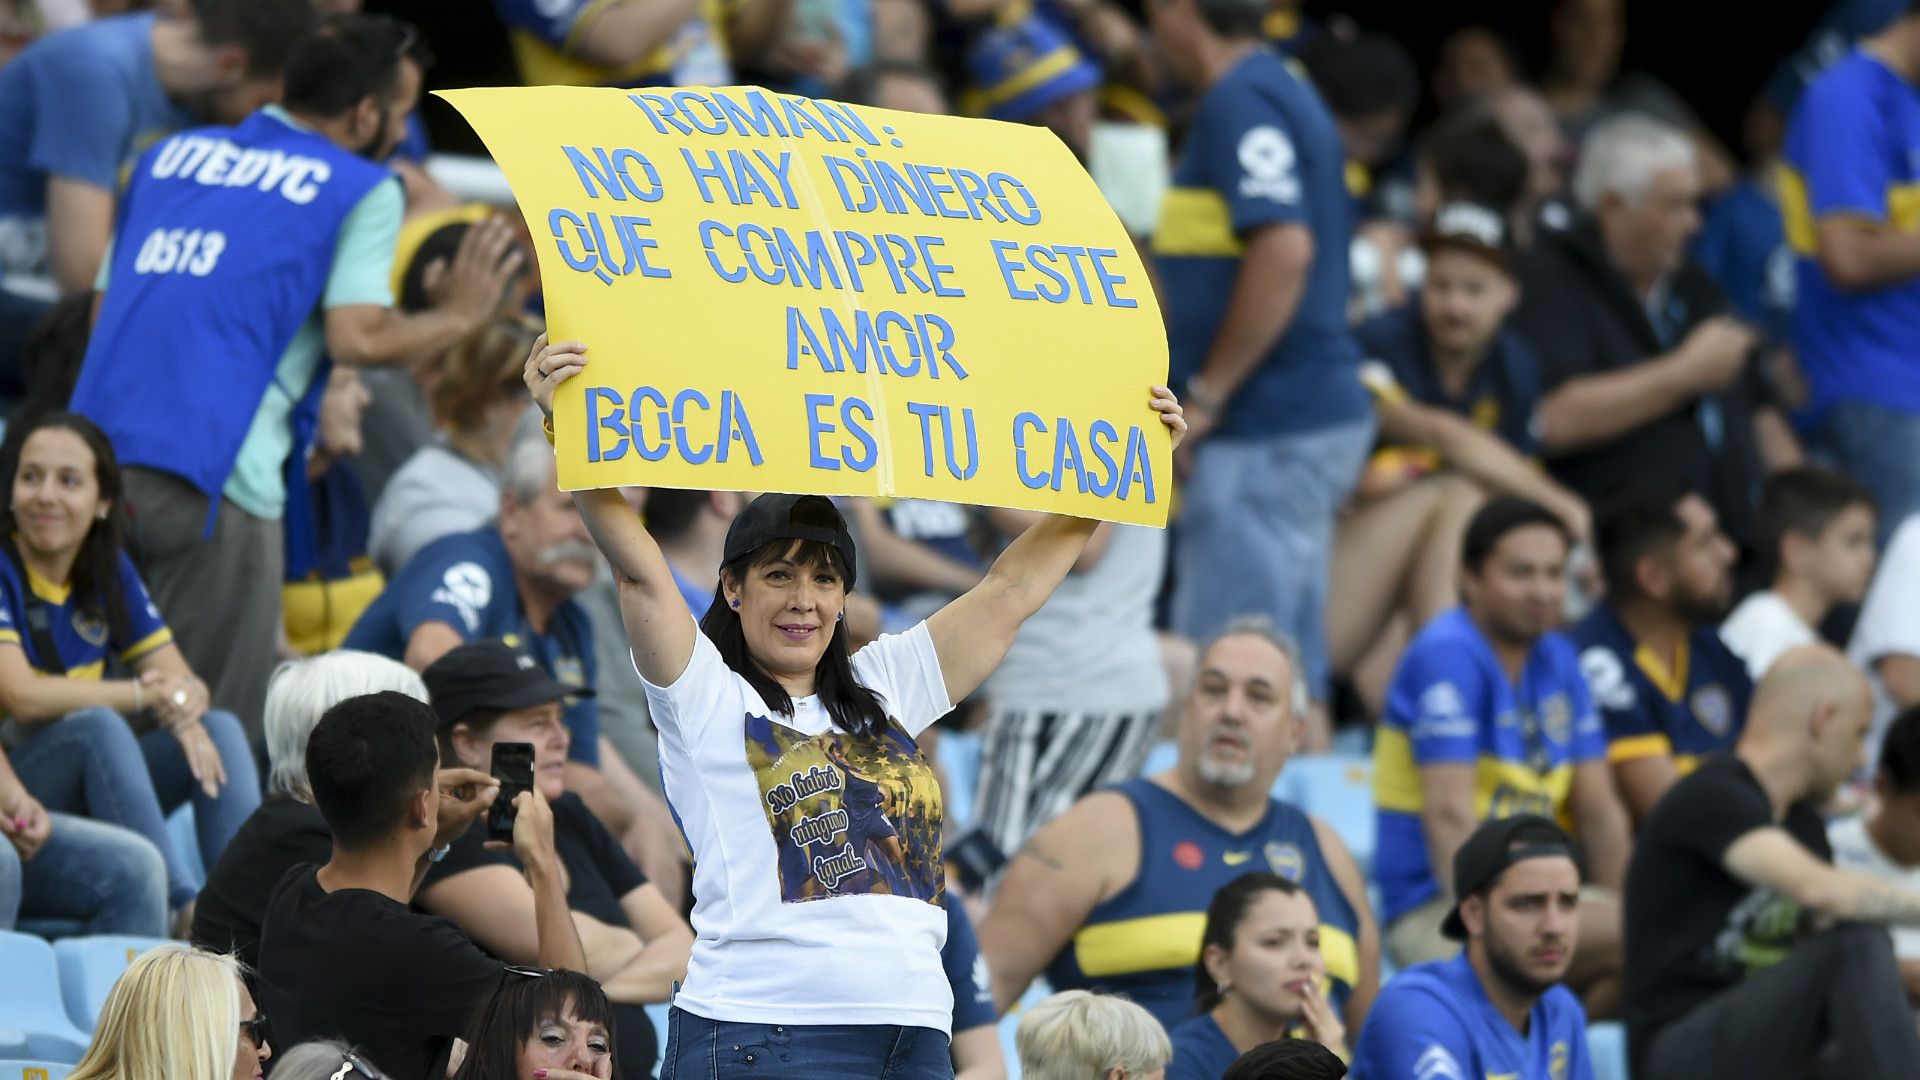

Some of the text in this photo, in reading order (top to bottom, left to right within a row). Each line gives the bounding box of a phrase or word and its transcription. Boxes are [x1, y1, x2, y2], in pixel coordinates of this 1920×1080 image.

[151, 134, 332, 205] UTEDYC
[561, 145, 664, 202] NO
[679, 147, 799, 209] HAY
[134, 228, 227, 277] 0513
[548, 208, 1138, 308] QUE COMPRE ESTE
[786, 306, 969, 380] AMOR
[585, 386, 1156, 503] BOCA ES TU CASA
[767, 785, 797, 813] No
[792, 810, 847, 845] ninguno
